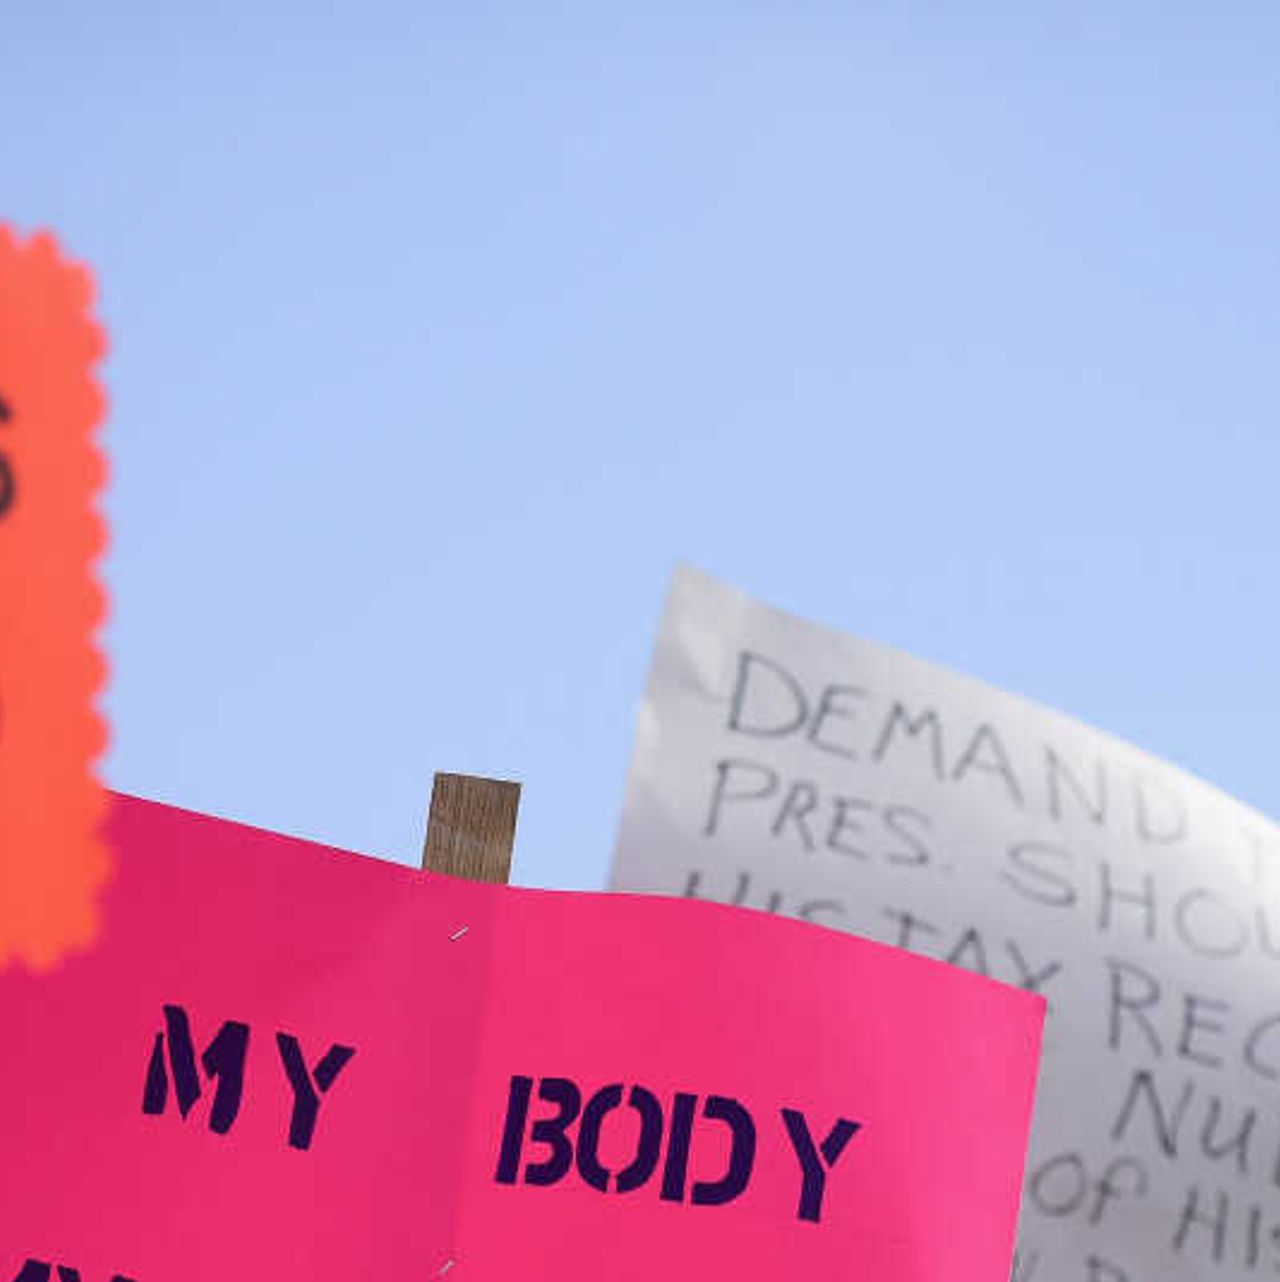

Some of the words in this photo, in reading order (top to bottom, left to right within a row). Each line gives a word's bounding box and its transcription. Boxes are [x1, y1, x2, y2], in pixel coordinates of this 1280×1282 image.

[703, 760, 955, 870] PRES.
[725, 650, 1188, 845] DEMAND
[142, 1004, 356, 1150] MY
[496, 1075, 861, 1223] BODY
[1030, 1153, 1148, 1226] OF
